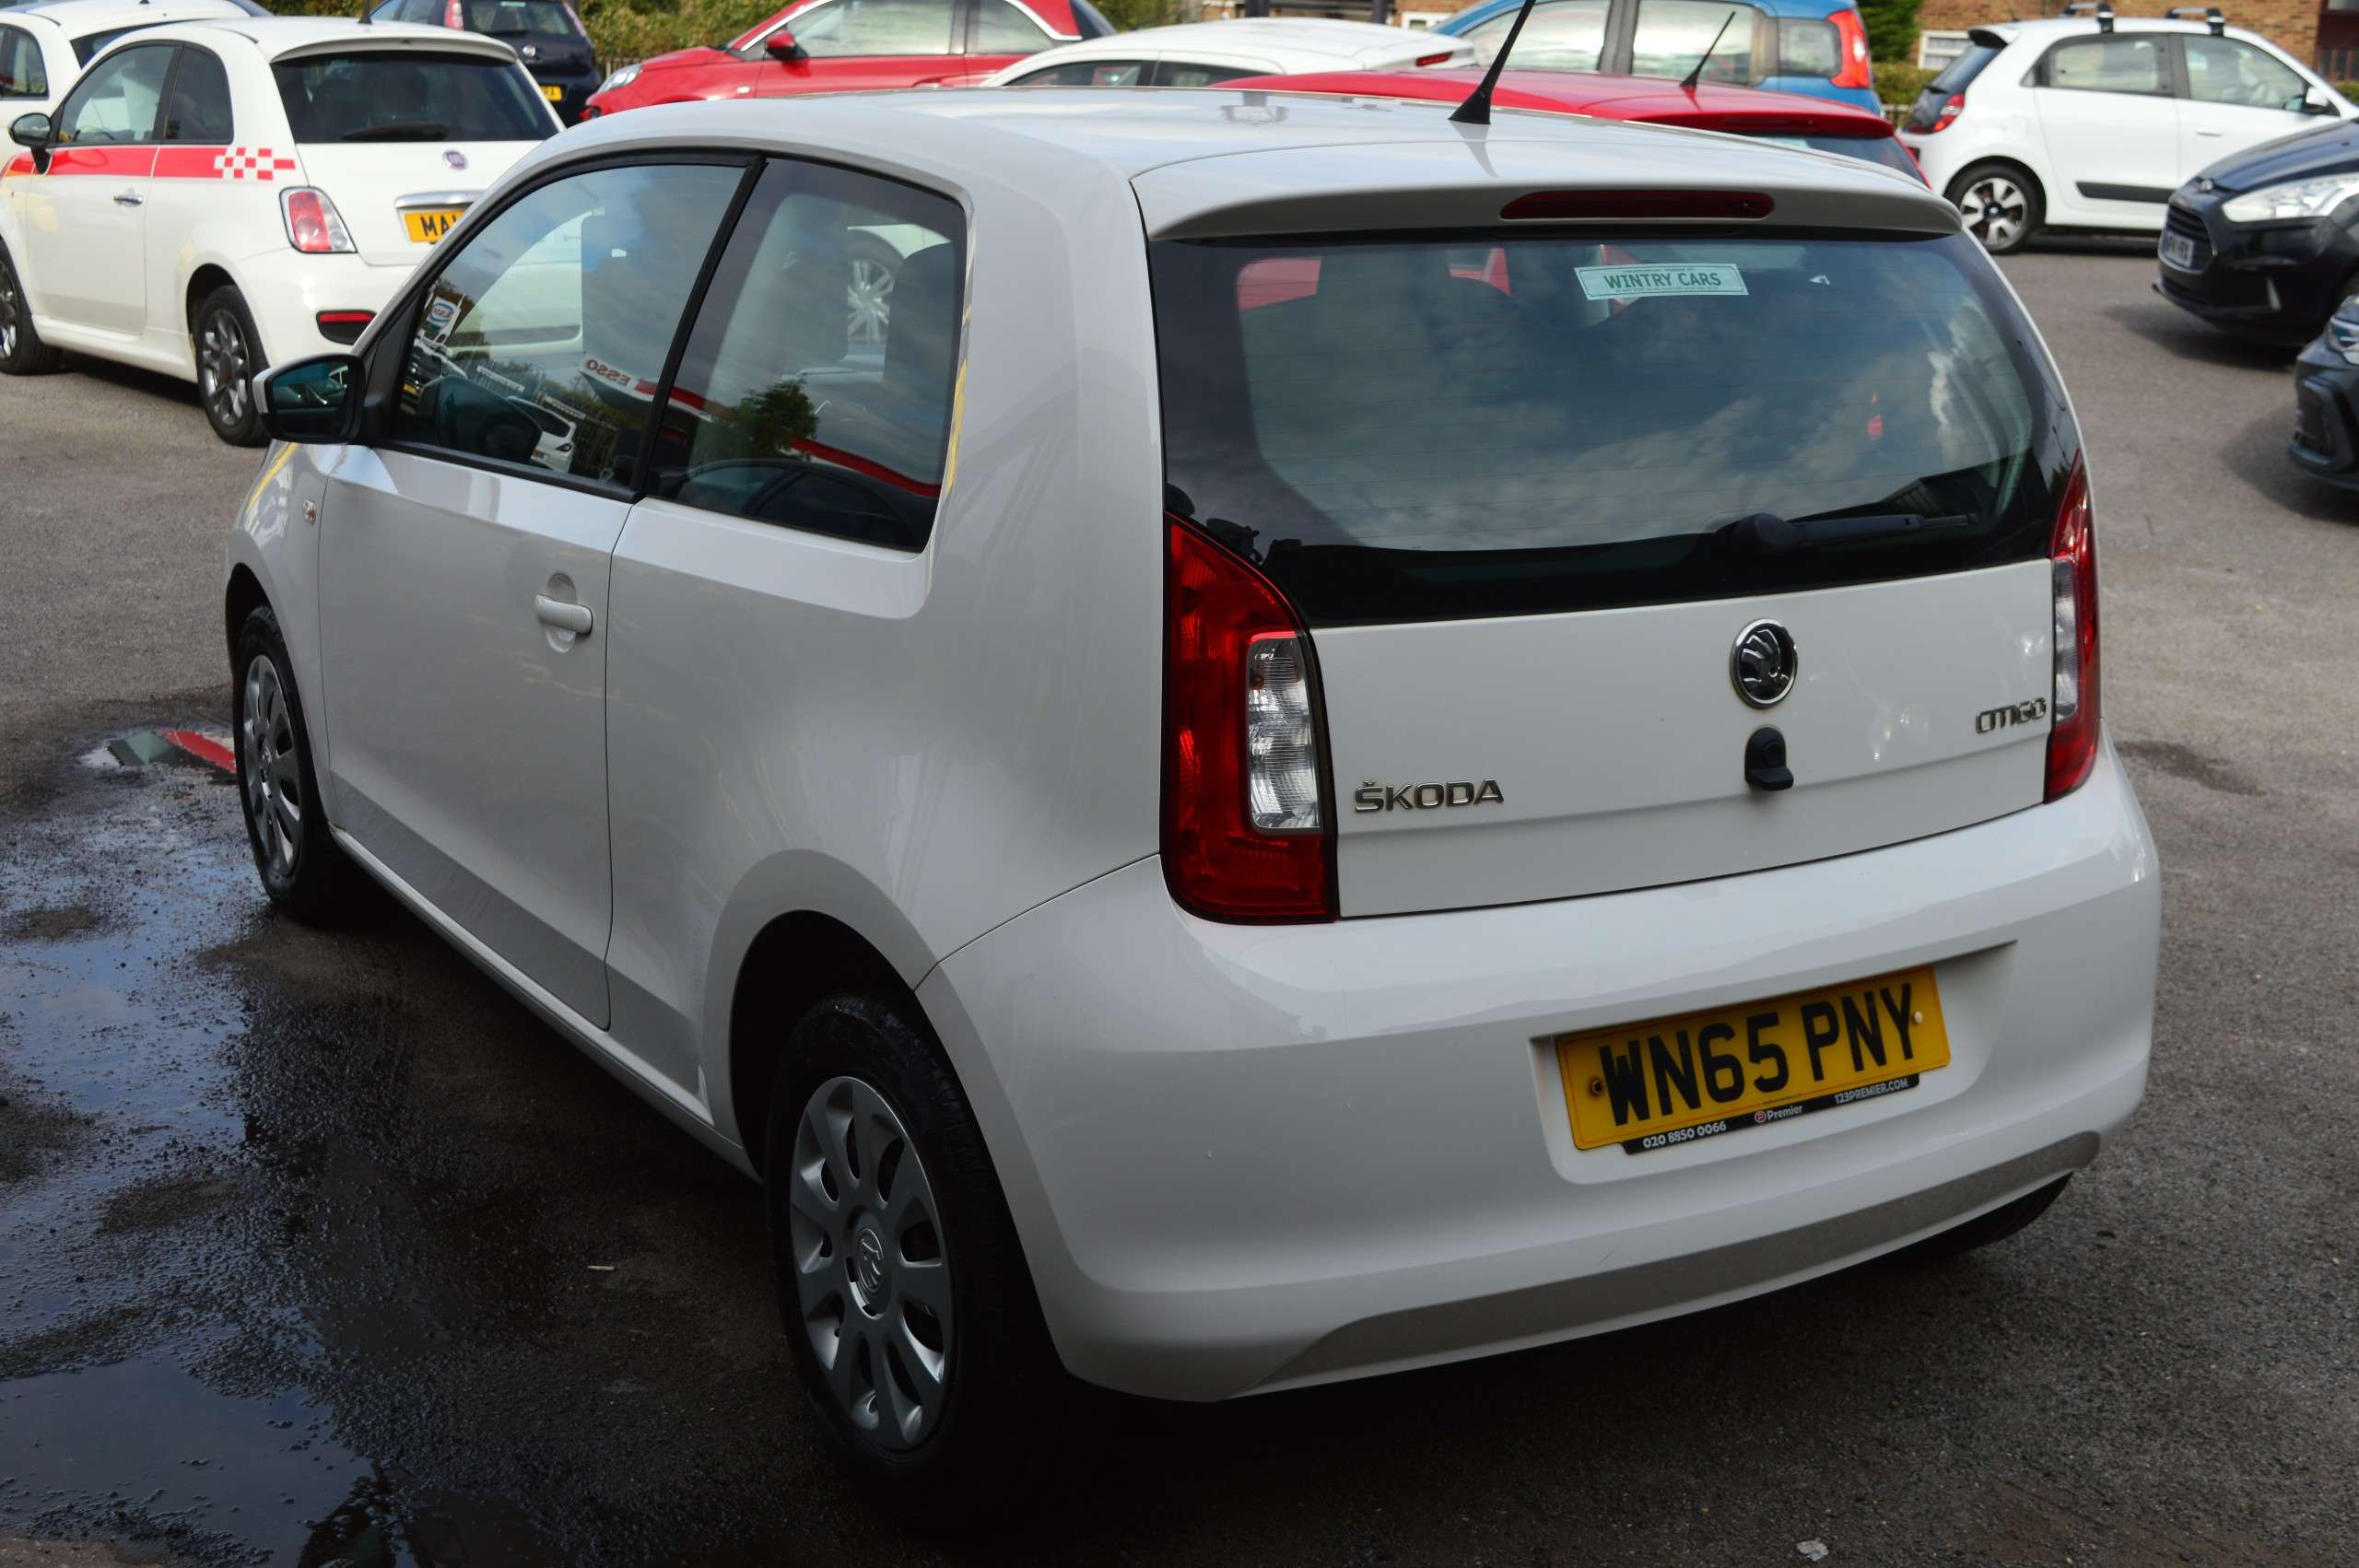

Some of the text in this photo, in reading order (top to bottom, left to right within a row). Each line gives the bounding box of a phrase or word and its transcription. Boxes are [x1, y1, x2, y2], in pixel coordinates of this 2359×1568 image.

[1603, 273, 1722, 289] WINTRY CARS
[1599, 983, 1914, 1126] WN65 PNY
[1834, 1078, 1909, 1105] 123PREMIER.COM
[1766, 1106, 1803, 1120] Premier
[1643, 1120, 1727, 1149] 020 8850 0066
